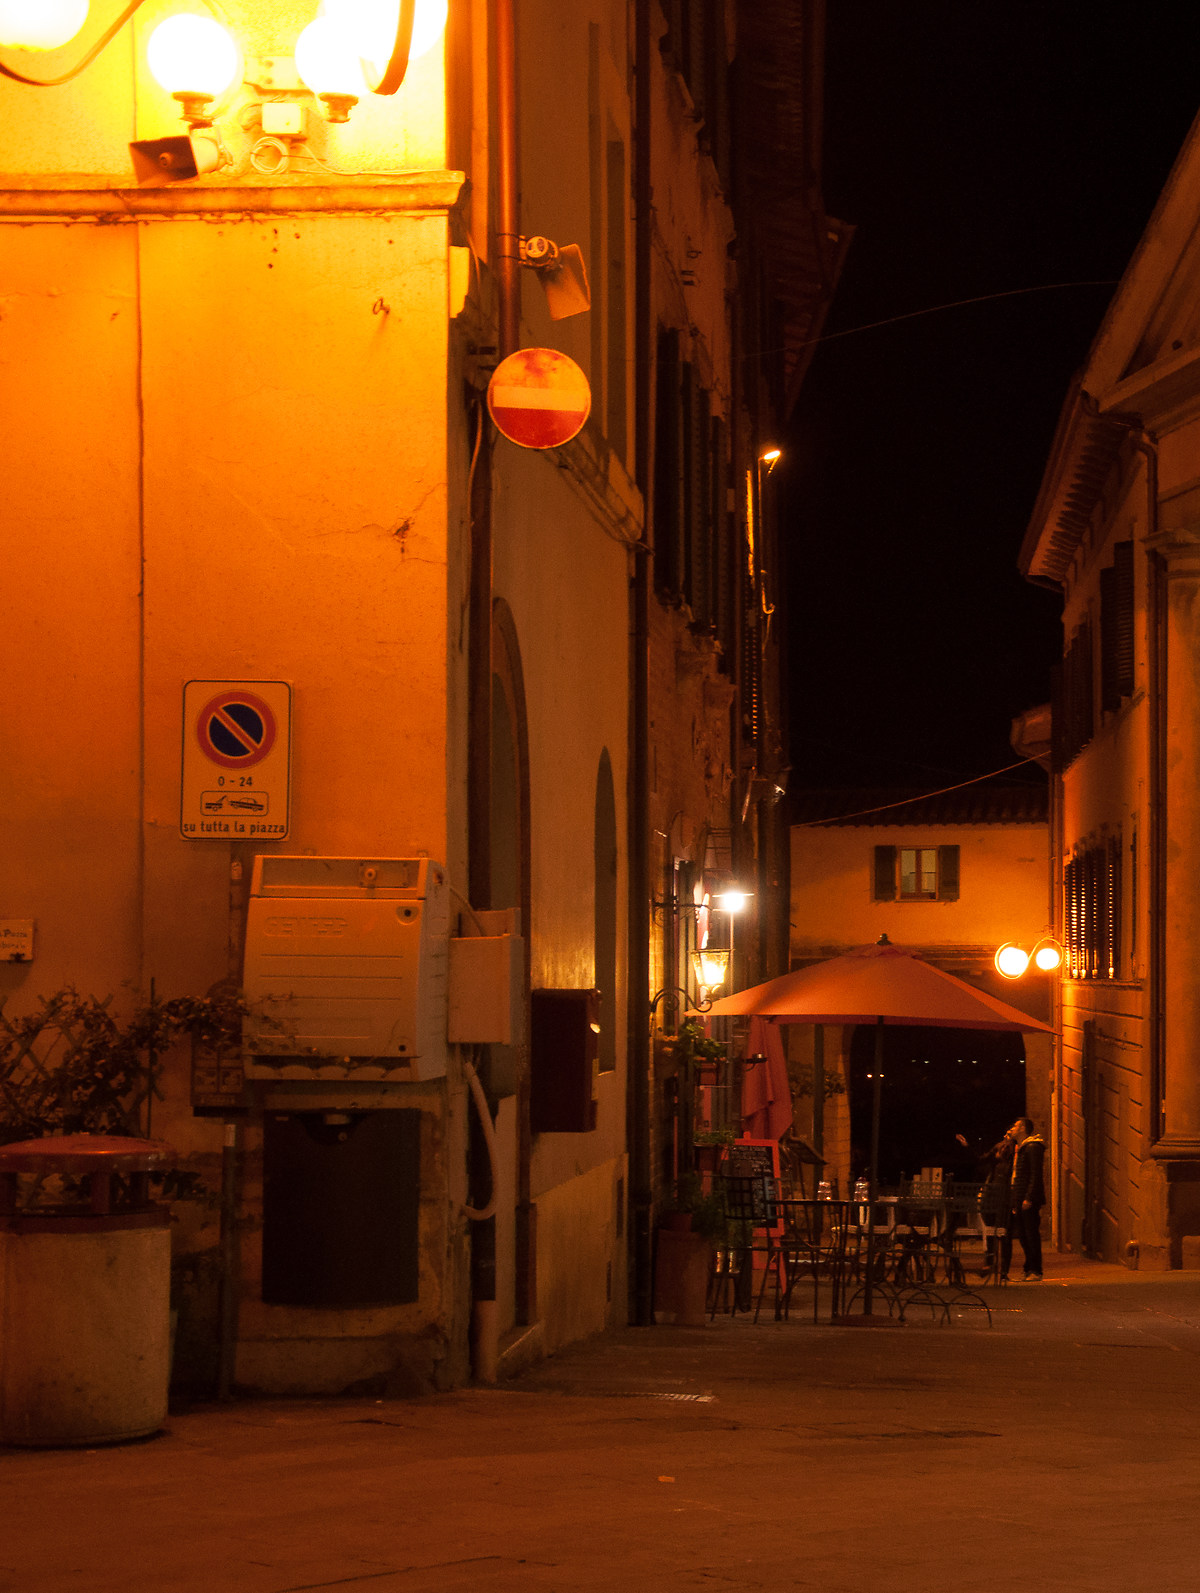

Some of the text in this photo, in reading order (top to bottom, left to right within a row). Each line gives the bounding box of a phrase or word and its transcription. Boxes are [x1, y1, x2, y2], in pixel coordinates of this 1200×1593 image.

[218, 776, 225, 786] 0
[239, 776, 252, 786] 24
[183, 821, 285, 834] su tutta la piazza
